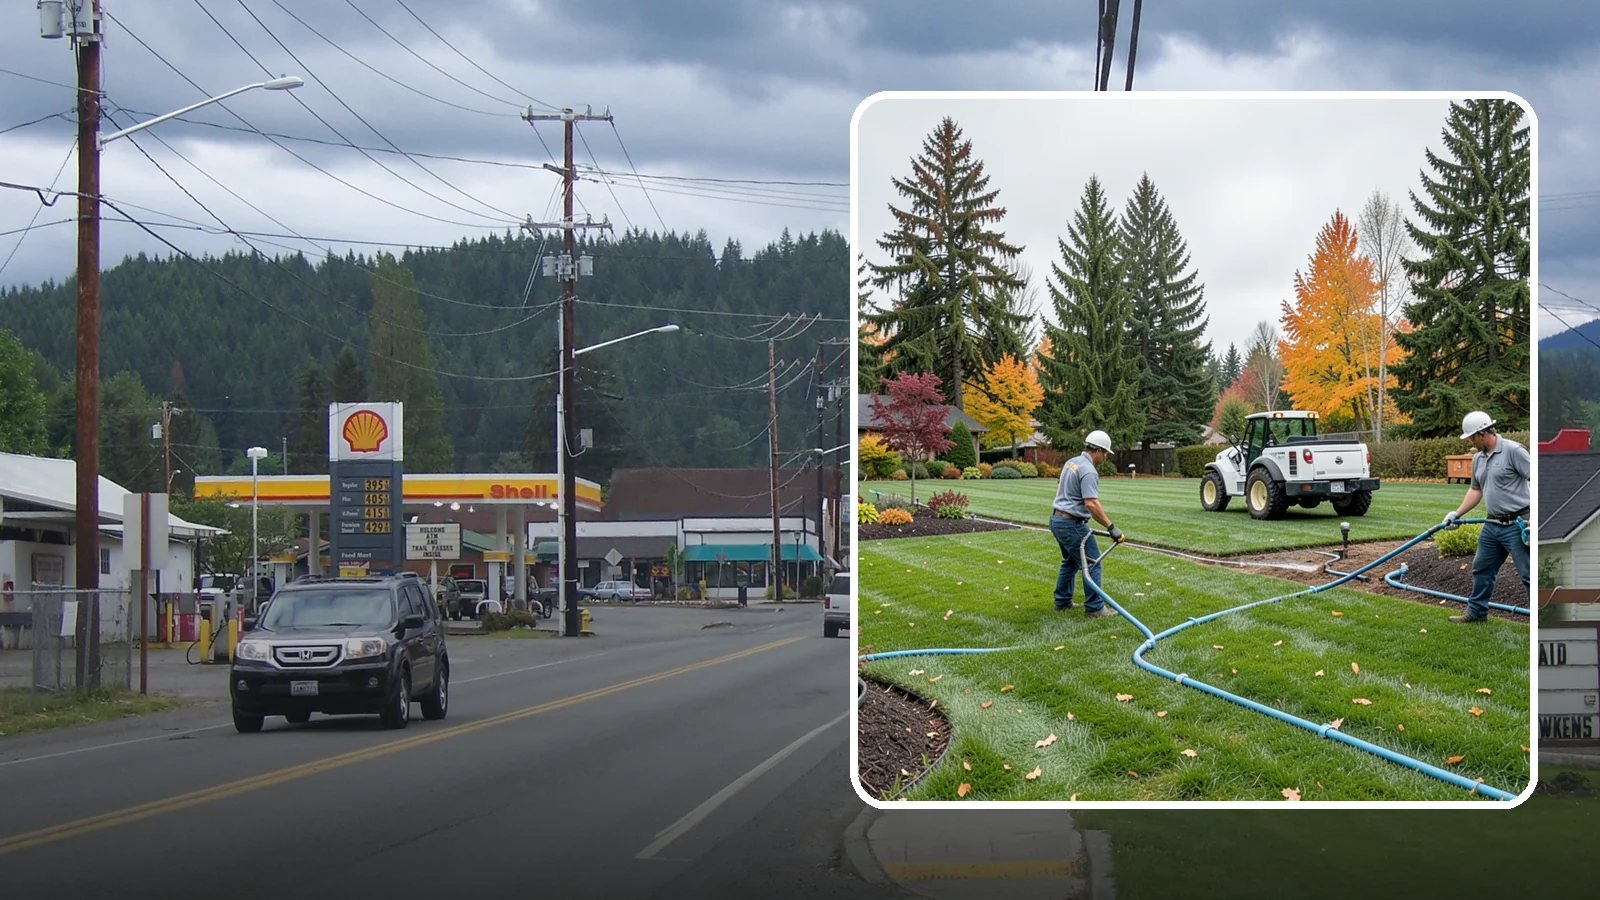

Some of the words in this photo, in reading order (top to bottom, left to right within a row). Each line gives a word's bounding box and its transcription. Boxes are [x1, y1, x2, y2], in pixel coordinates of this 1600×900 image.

[366, 480, 383, 490] 395
[490, 484, 547, 499] Shell
[365, 494, 383, 504] 405
[365, 508, 383, 518] 415
[365, 522, 383, 532] 429
